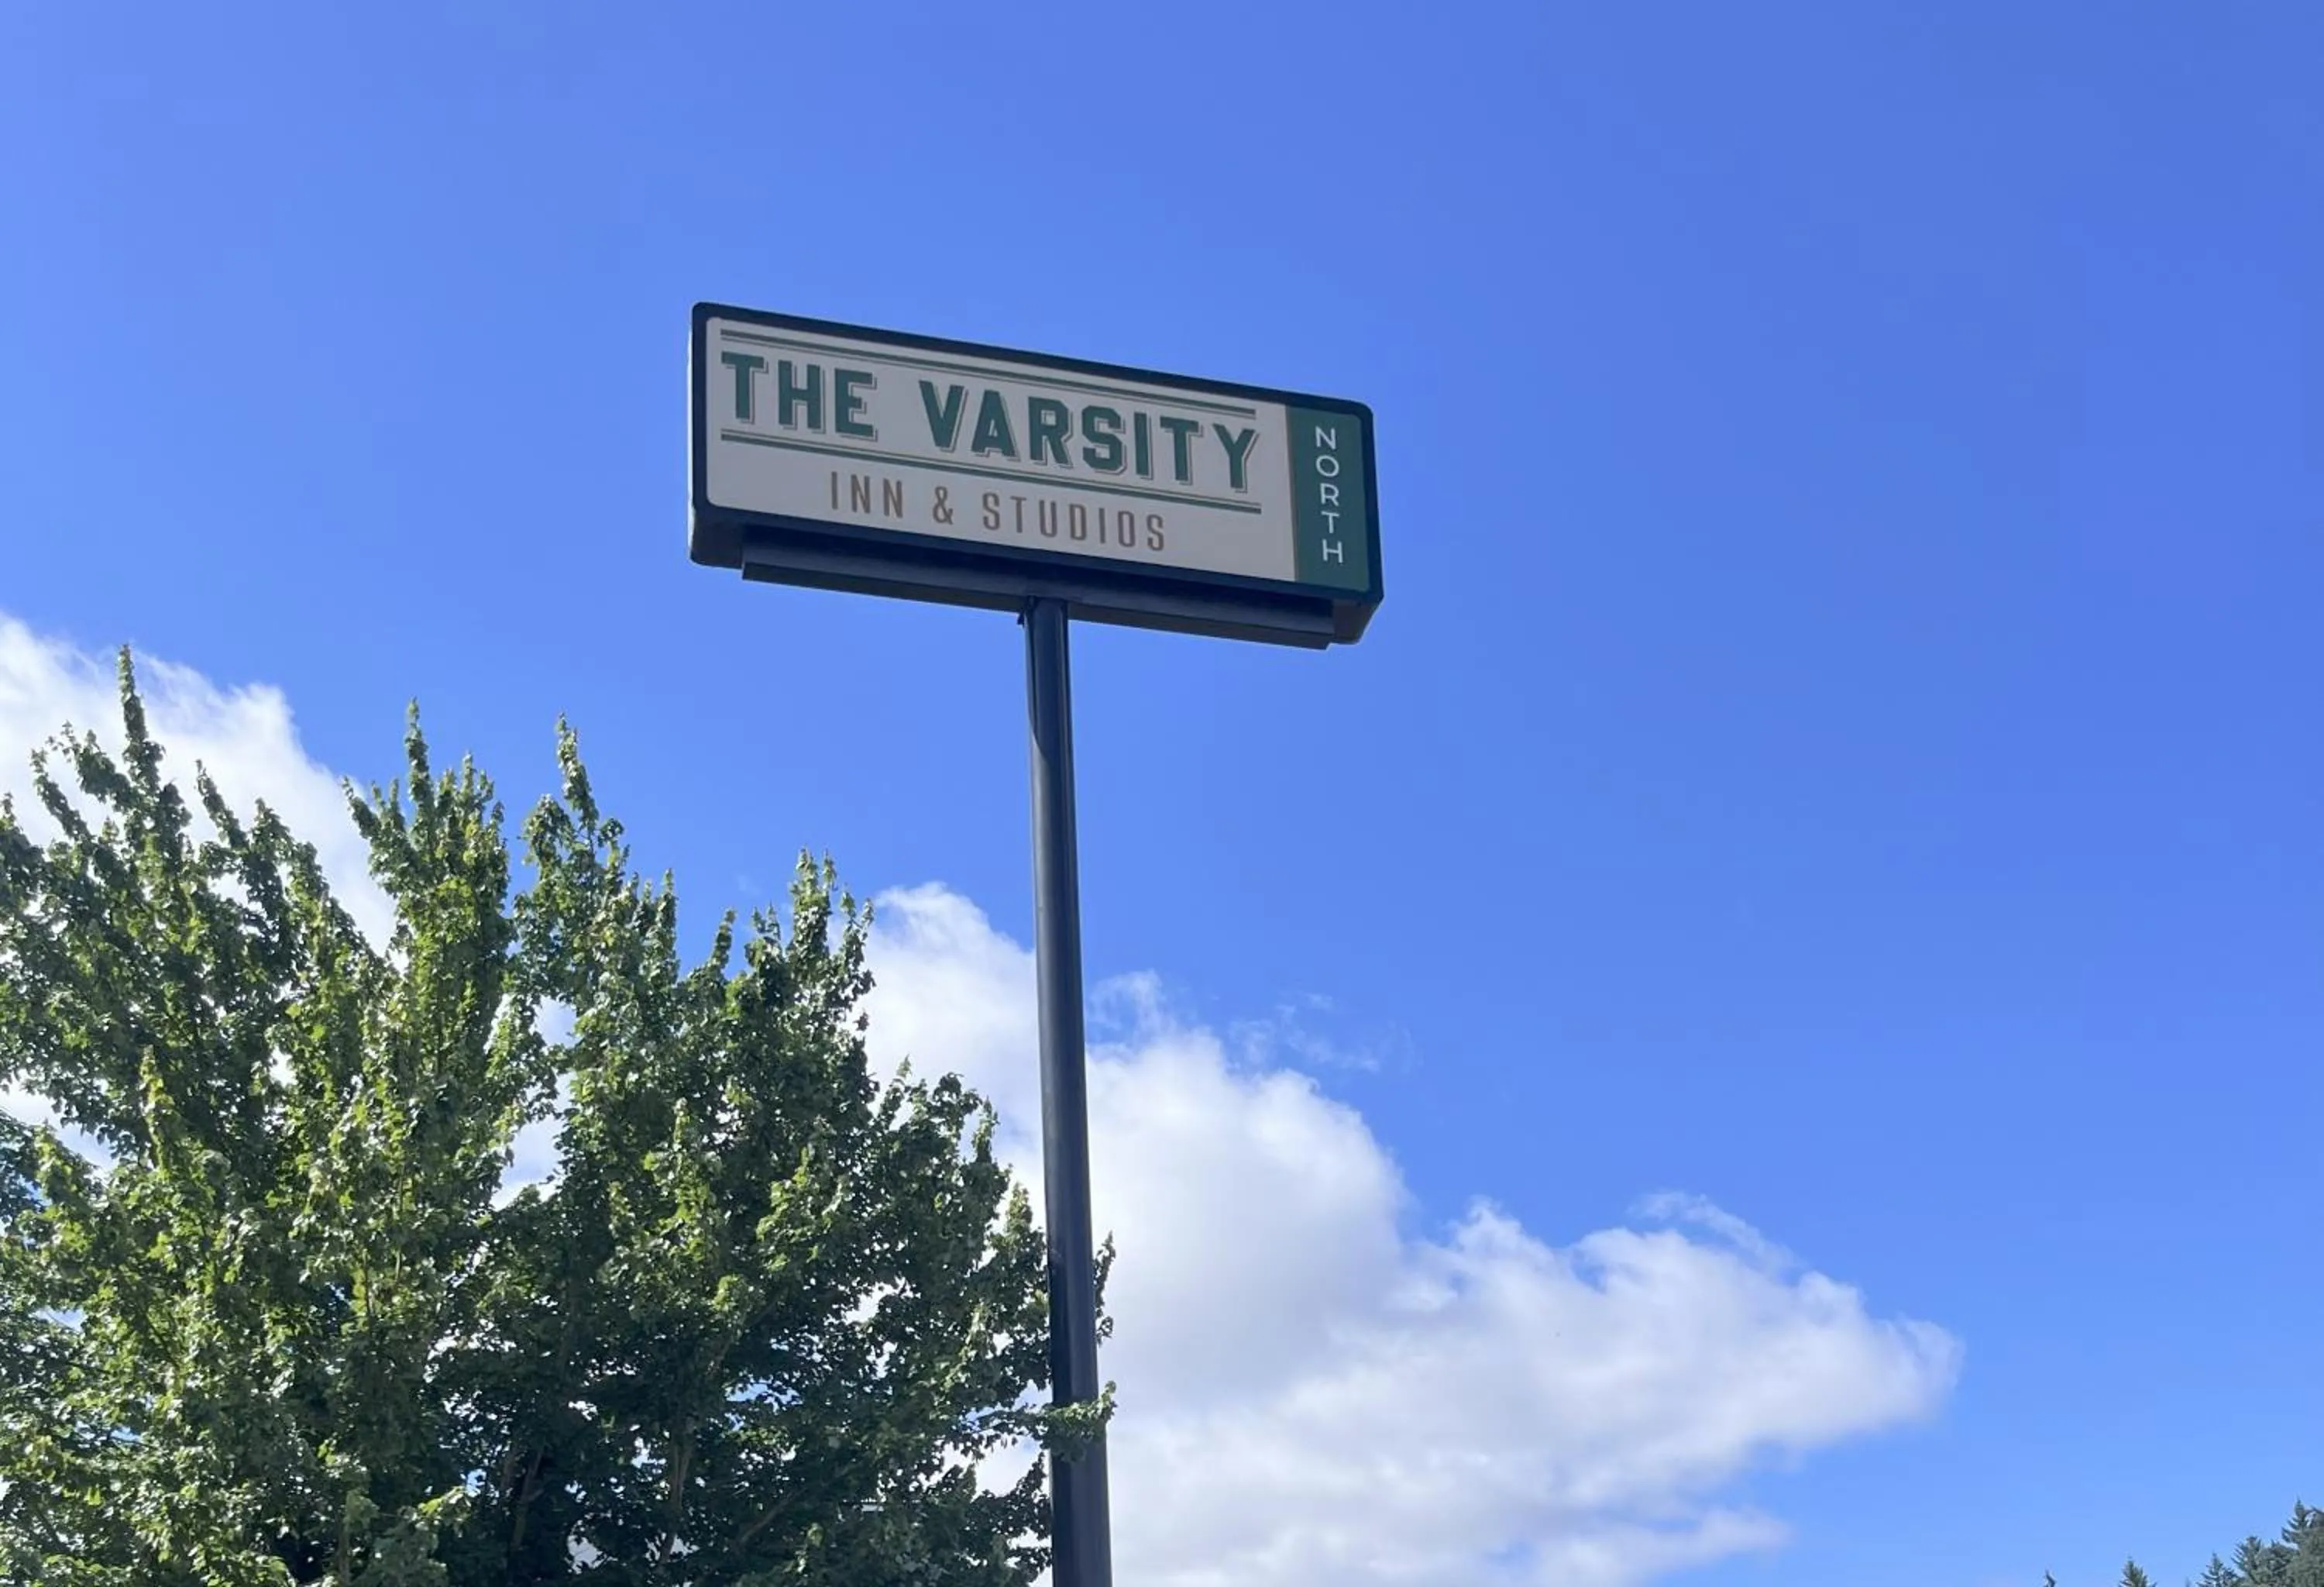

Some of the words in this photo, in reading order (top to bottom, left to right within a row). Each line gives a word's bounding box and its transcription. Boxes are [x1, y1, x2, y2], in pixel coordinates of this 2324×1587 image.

[721, 351, 878, 441] THE
[918, 380, 1259, 493] VARSITY
[831, 471, 903, 518] INN
[933, 486, 954, 525] &
[982, 493, 1164, 551] STUDIOS
[1315, 425, 1343, 564] NORTH
